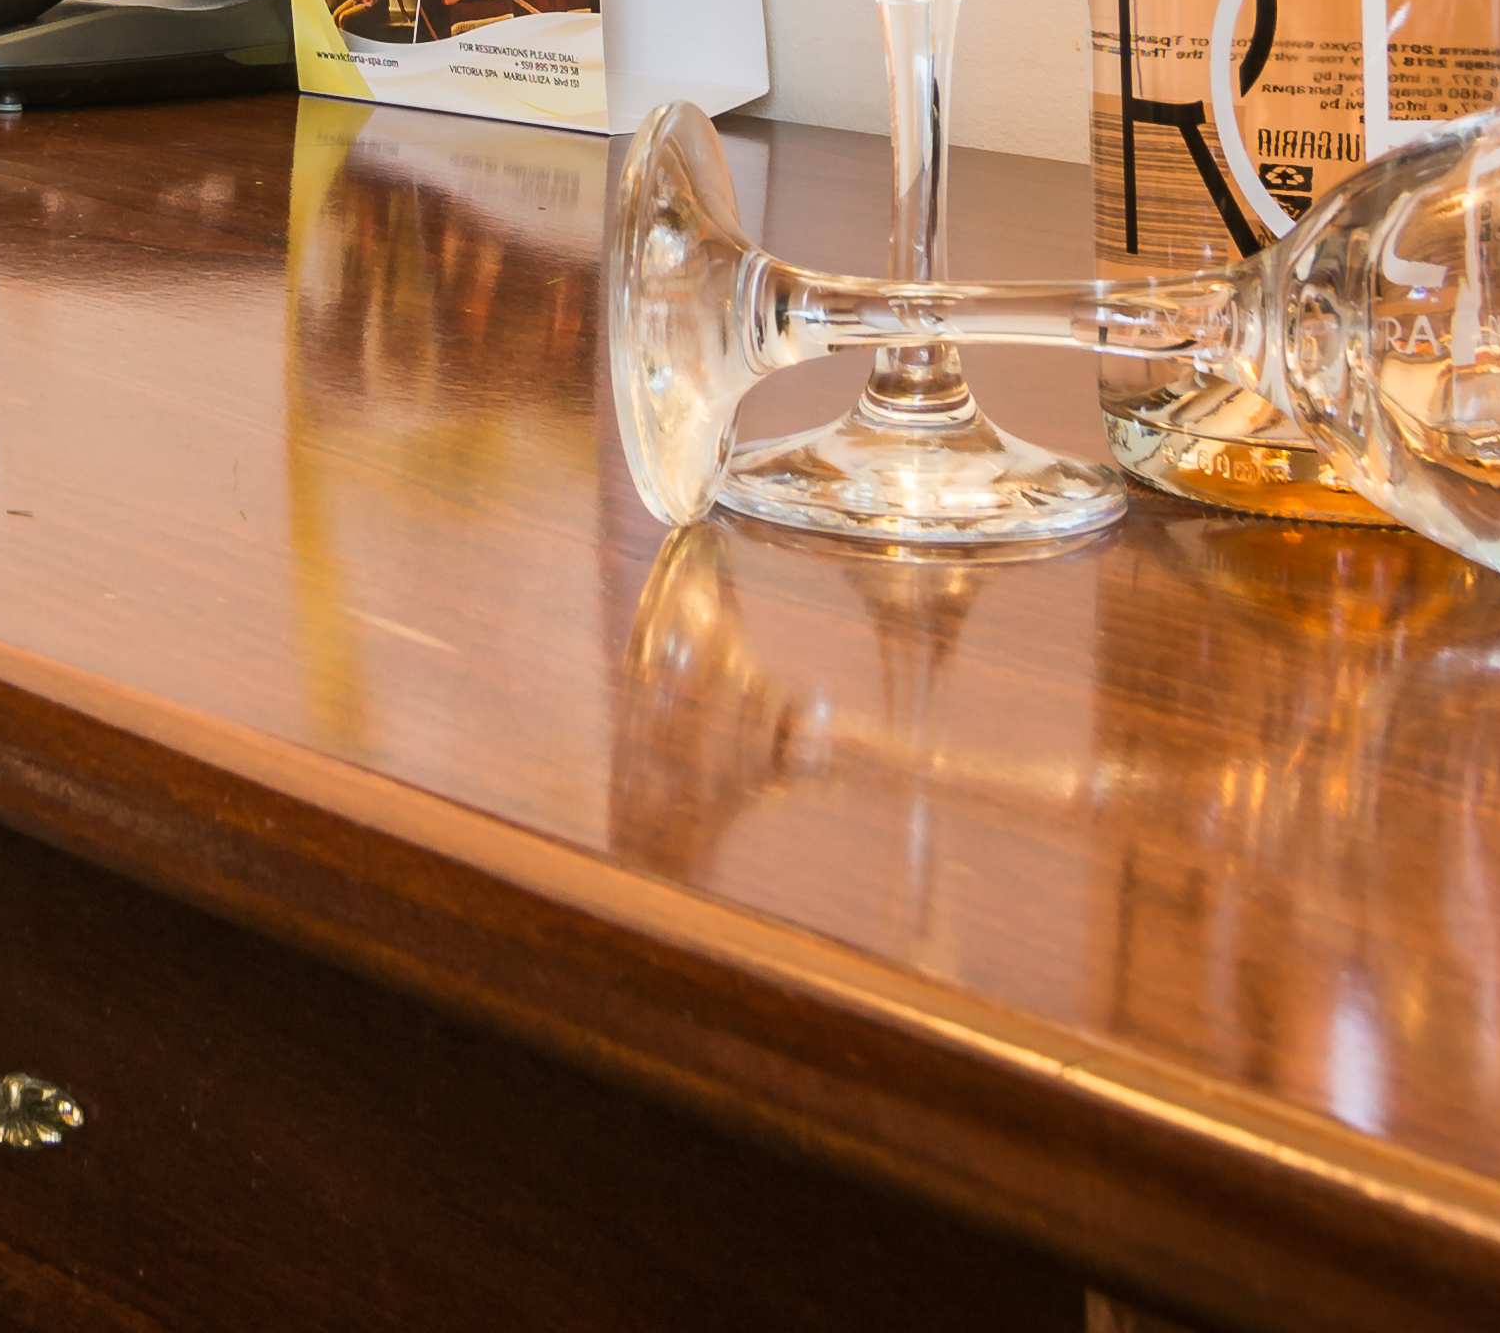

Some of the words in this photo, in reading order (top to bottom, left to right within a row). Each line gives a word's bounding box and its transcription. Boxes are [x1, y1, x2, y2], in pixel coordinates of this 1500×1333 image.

[315, 51, 399, 67] www.victoria-spa.com
[459, 43, 474, 54] FOR
[474, 44, 529, 59] RESERVATIONS
[529, 50, 557, 62] PLEASE
[449, 65, 484, 78] VICTORIA
[484, 69, 499, 80] SPA
[503, 71, 528, 83] MARIA
